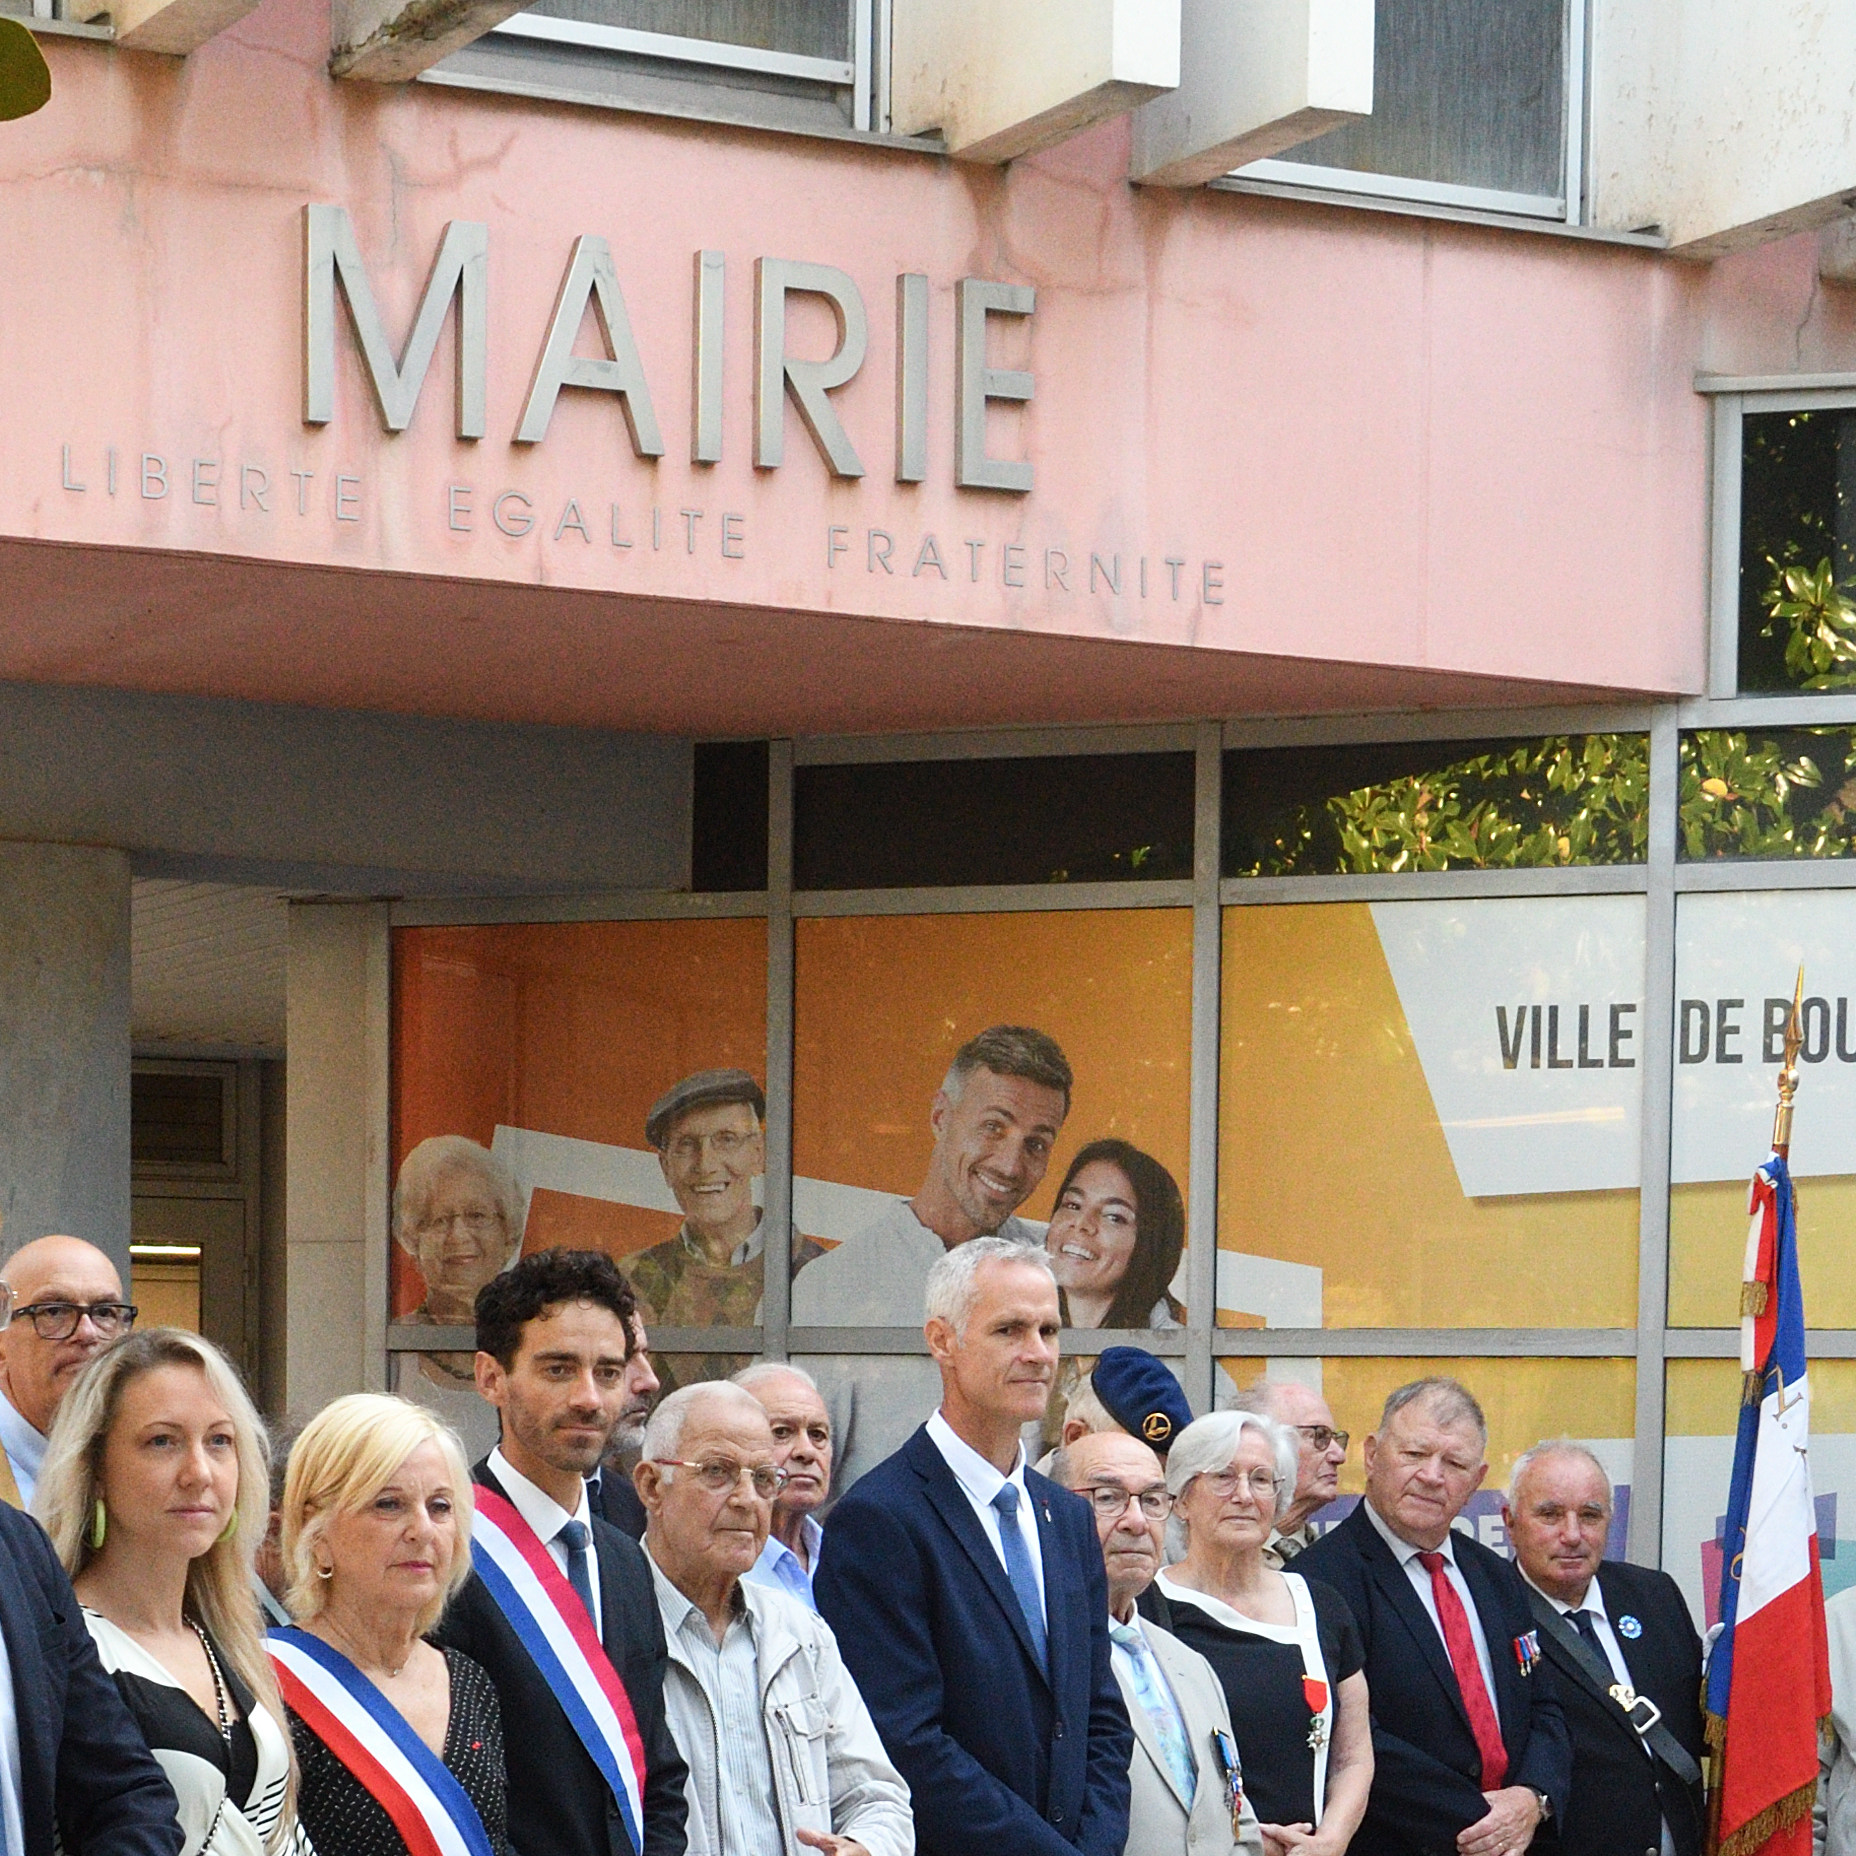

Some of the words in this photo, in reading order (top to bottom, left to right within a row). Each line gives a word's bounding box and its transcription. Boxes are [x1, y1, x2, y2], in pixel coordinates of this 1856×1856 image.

[301, 203, 1037, 497] MAIRIE
[62, 443, 362, 522] LIBERTE
[448, 484, 746, 560] EGALITE
[827, 525, 1225, 605] FRATERNITE
[1496, 1002, 1637, 1071] VILLE
[1680, 999, 1745, 1065] DE
